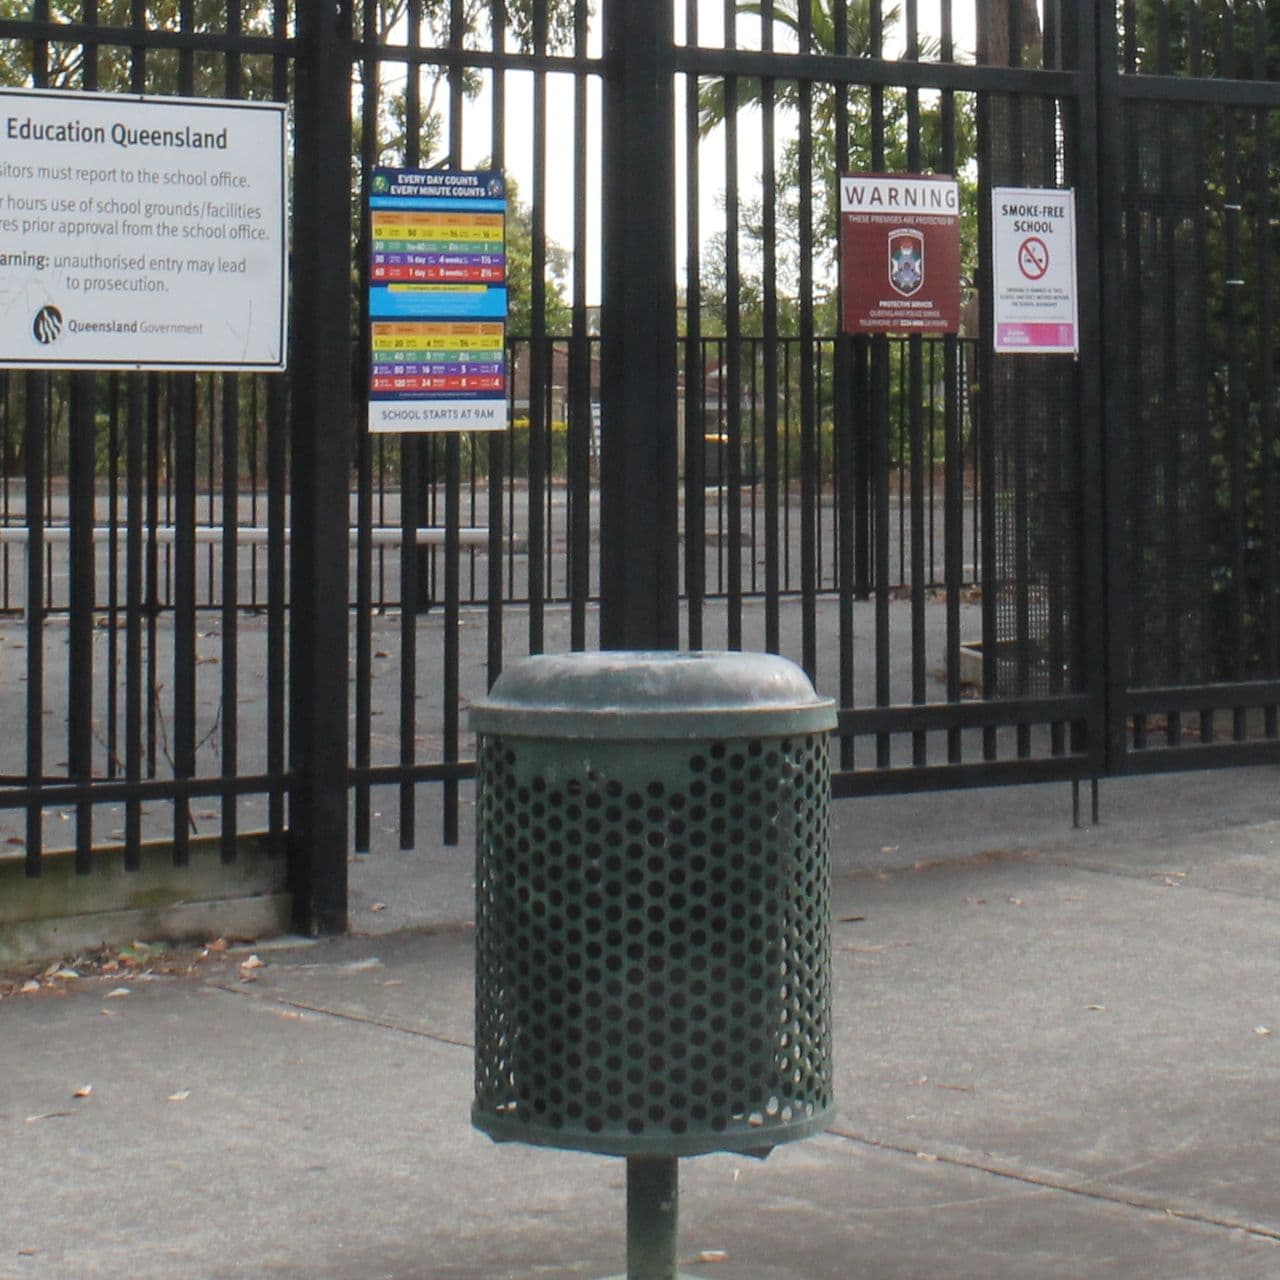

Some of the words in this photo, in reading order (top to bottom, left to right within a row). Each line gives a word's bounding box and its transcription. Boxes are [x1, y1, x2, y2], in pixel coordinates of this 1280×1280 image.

[6, 117, 105, 144] Education
[111, 122, 228, 149] Queensland
[37, 166, 72, 180] must
[76, 167, 117, 185] report
[120, 169, 134, 183] to
[138, 168, 160, 184] the
[163, 170, 207, 187] school
[210, 172, 251, 188] office.
[398, 174, 426, 185] EVERY
[426, 175, 444, 185] DAY
[445, 176, 478, 186] COUNTS
[390, 185, 419, 195] EVERY
[419, 186, 451, 196] MINUTE
[452, 187, 485, 197] COUNTS
[844, 186, 956, 208] WARNING
[7, 194, 48, 211] hours
[51, 199, 76, 213] use
[79, 196, 94, 213] of
[96, 197, 141, 215] school
[144, 199, 261, 219] grounds/facilities
[1001, 204, 1065, 218] SMOKE-FREE
[22, 218, 55, 235] prior
[58, 219, 118, 237] approval
[122, 220, 153, 237] from
[156, 222, 179, 238] the
[182, 222, 226, 239] school
[229, 224, 269, 241] office.
[1013, 220, 1054, 233] SCHOOL
[53, 253, 146, 271] unauthorised
[149, 257, 183, 273] entry
[186, 261, 215, 274] may
[218, 257, 247, 273] lead
[66, 276, 80, 291] to
[84, 276, 169, 295] prosecution.
[68, 319, 137, 335] Queensland
[140, 322, 203, 335] Government
[381, 409, 420, 420] SCHOOL
[423, 409, 458, 420] STARTS
[460, 409, 472, 419] AT
[474, 408, 494, 418] 9AM
